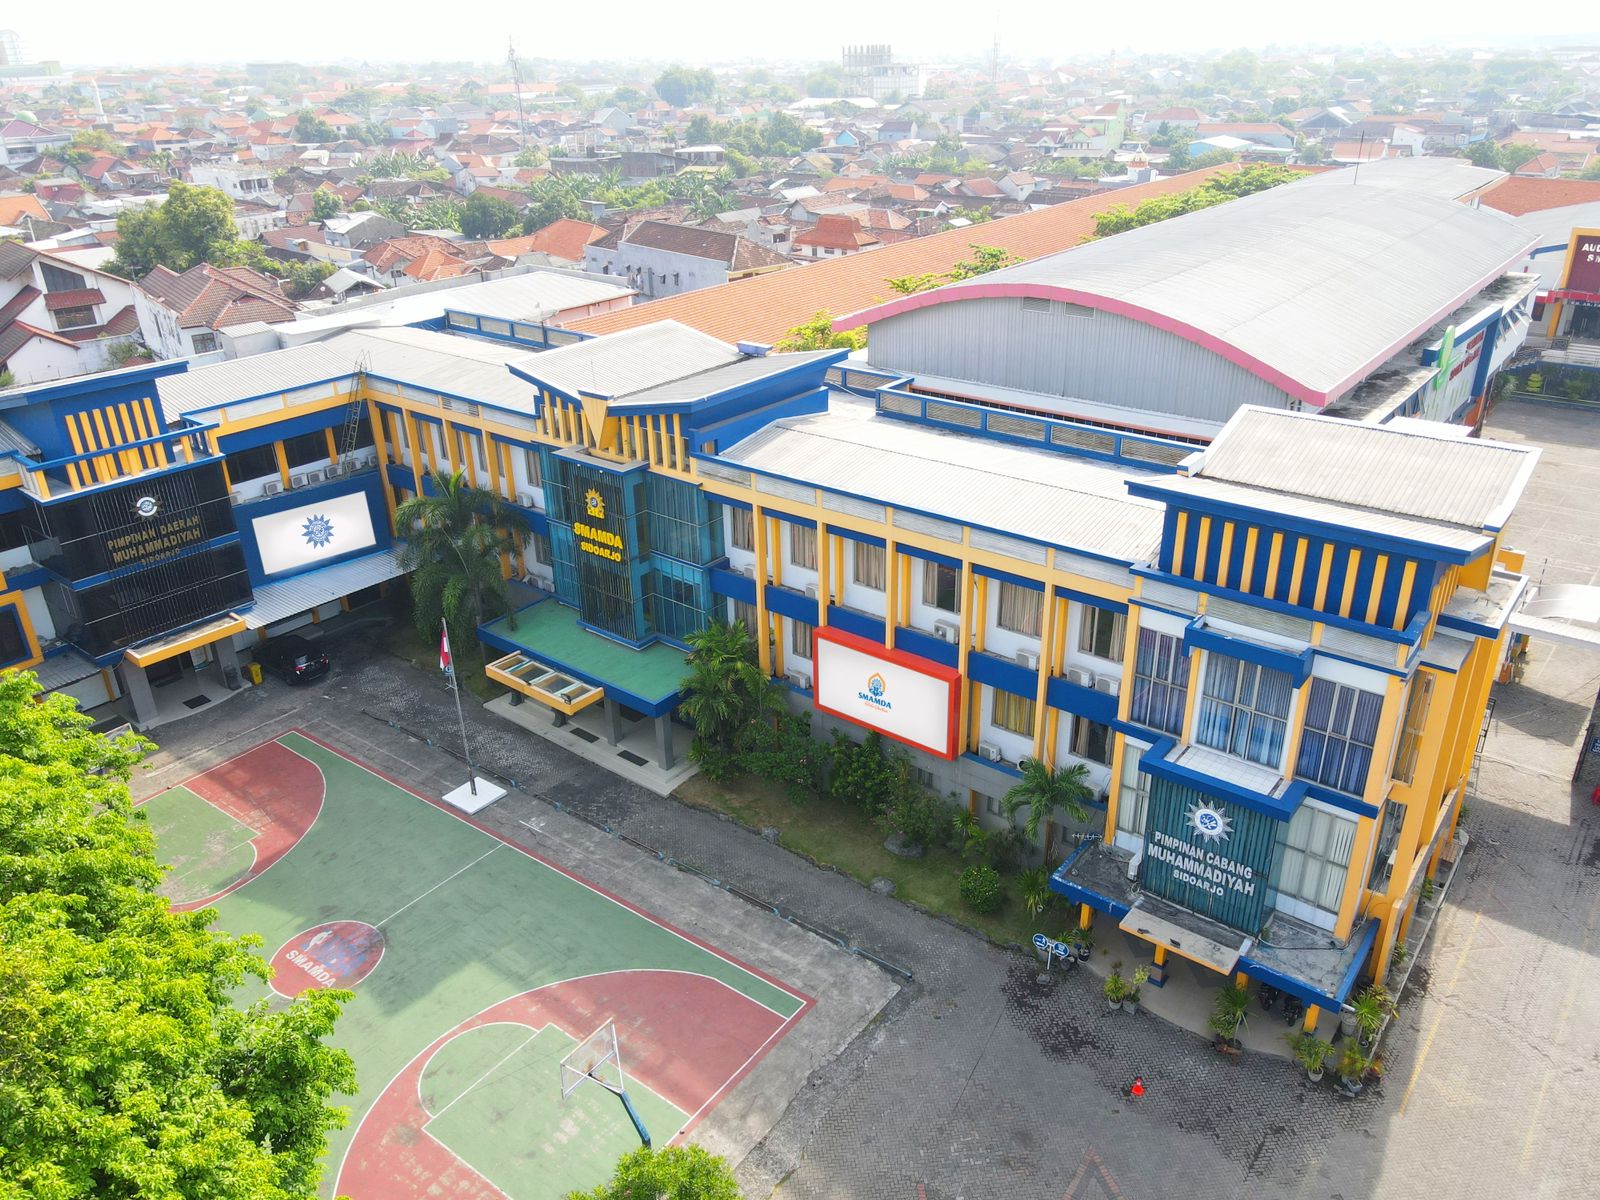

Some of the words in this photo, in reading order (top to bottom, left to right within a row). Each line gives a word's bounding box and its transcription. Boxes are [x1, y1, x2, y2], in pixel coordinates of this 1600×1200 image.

[107, 528, 156, 550] PIMPINAN
[160, 515, 200, 534] DAERAH
[113, 528, 201, 563] MUHAMMADIYAH
[574, 522, 623, 549] SMAMDA
[581, 541, 621, 562] SIDOARJO
[858, 692, 892, 709] SMAMDA
[1147, 843, 1255, 896] MUHAMMADIYAH
[1154, 831, 1205, 860] PIMPINAN
[1206, 852, 1253, 879] CABANG
[1173, 869, 1224, 896] SIDOARJO
[285, 949, 337, 988] SMAMDA
